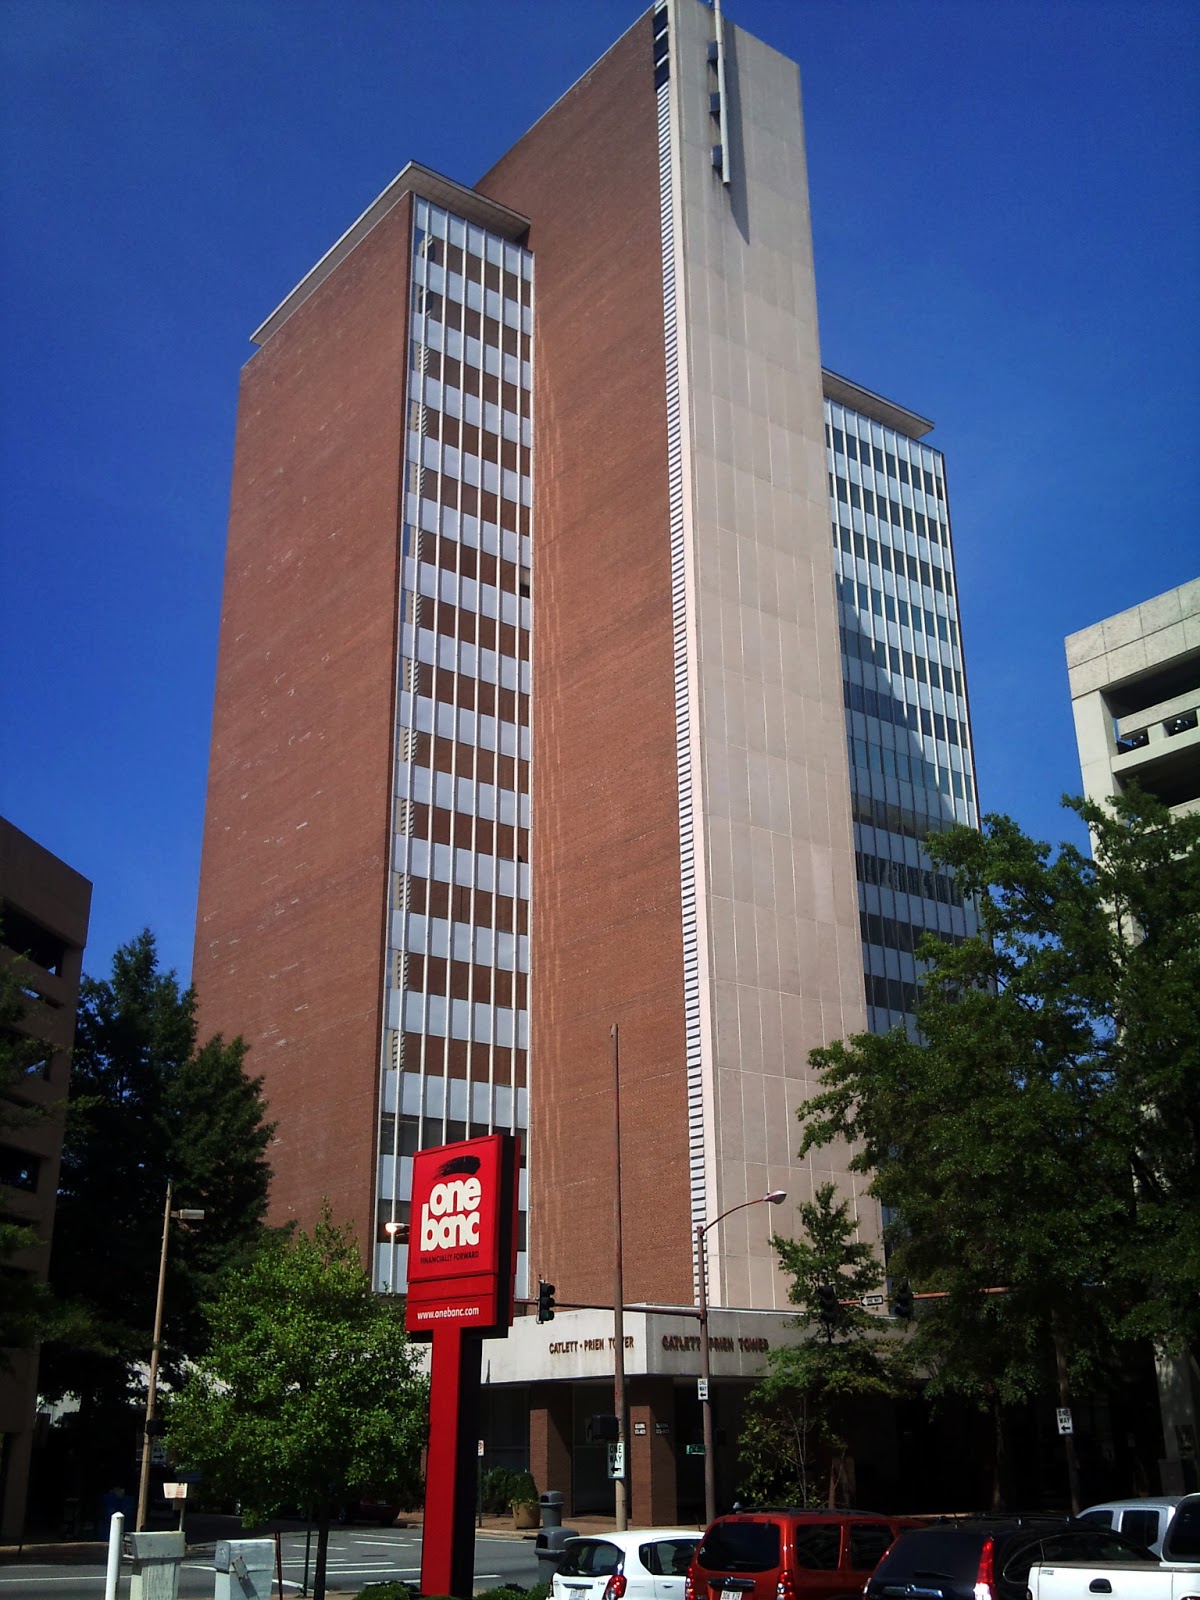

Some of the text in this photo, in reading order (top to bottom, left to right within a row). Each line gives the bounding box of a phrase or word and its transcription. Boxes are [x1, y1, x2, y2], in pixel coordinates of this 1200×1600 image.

[429, 1177, 482, 1217] one
[420, 1202, 481, 1252] banc
[420, 1250, 480, 1265] FINANCIALLY FORWARD
[417, 1306, 480, 1320] www.onebanc.com
[549, 1341, 578, 1354] CATLETT
[608, 1335, 635, 1350] TER
[662, 1335, 702, 1352] CATLETT
[738, 1337, 770, 1353] TOWER
[609, 1445, 622, 1454] ONE
[609, 1454, 622, 1463] WAY
